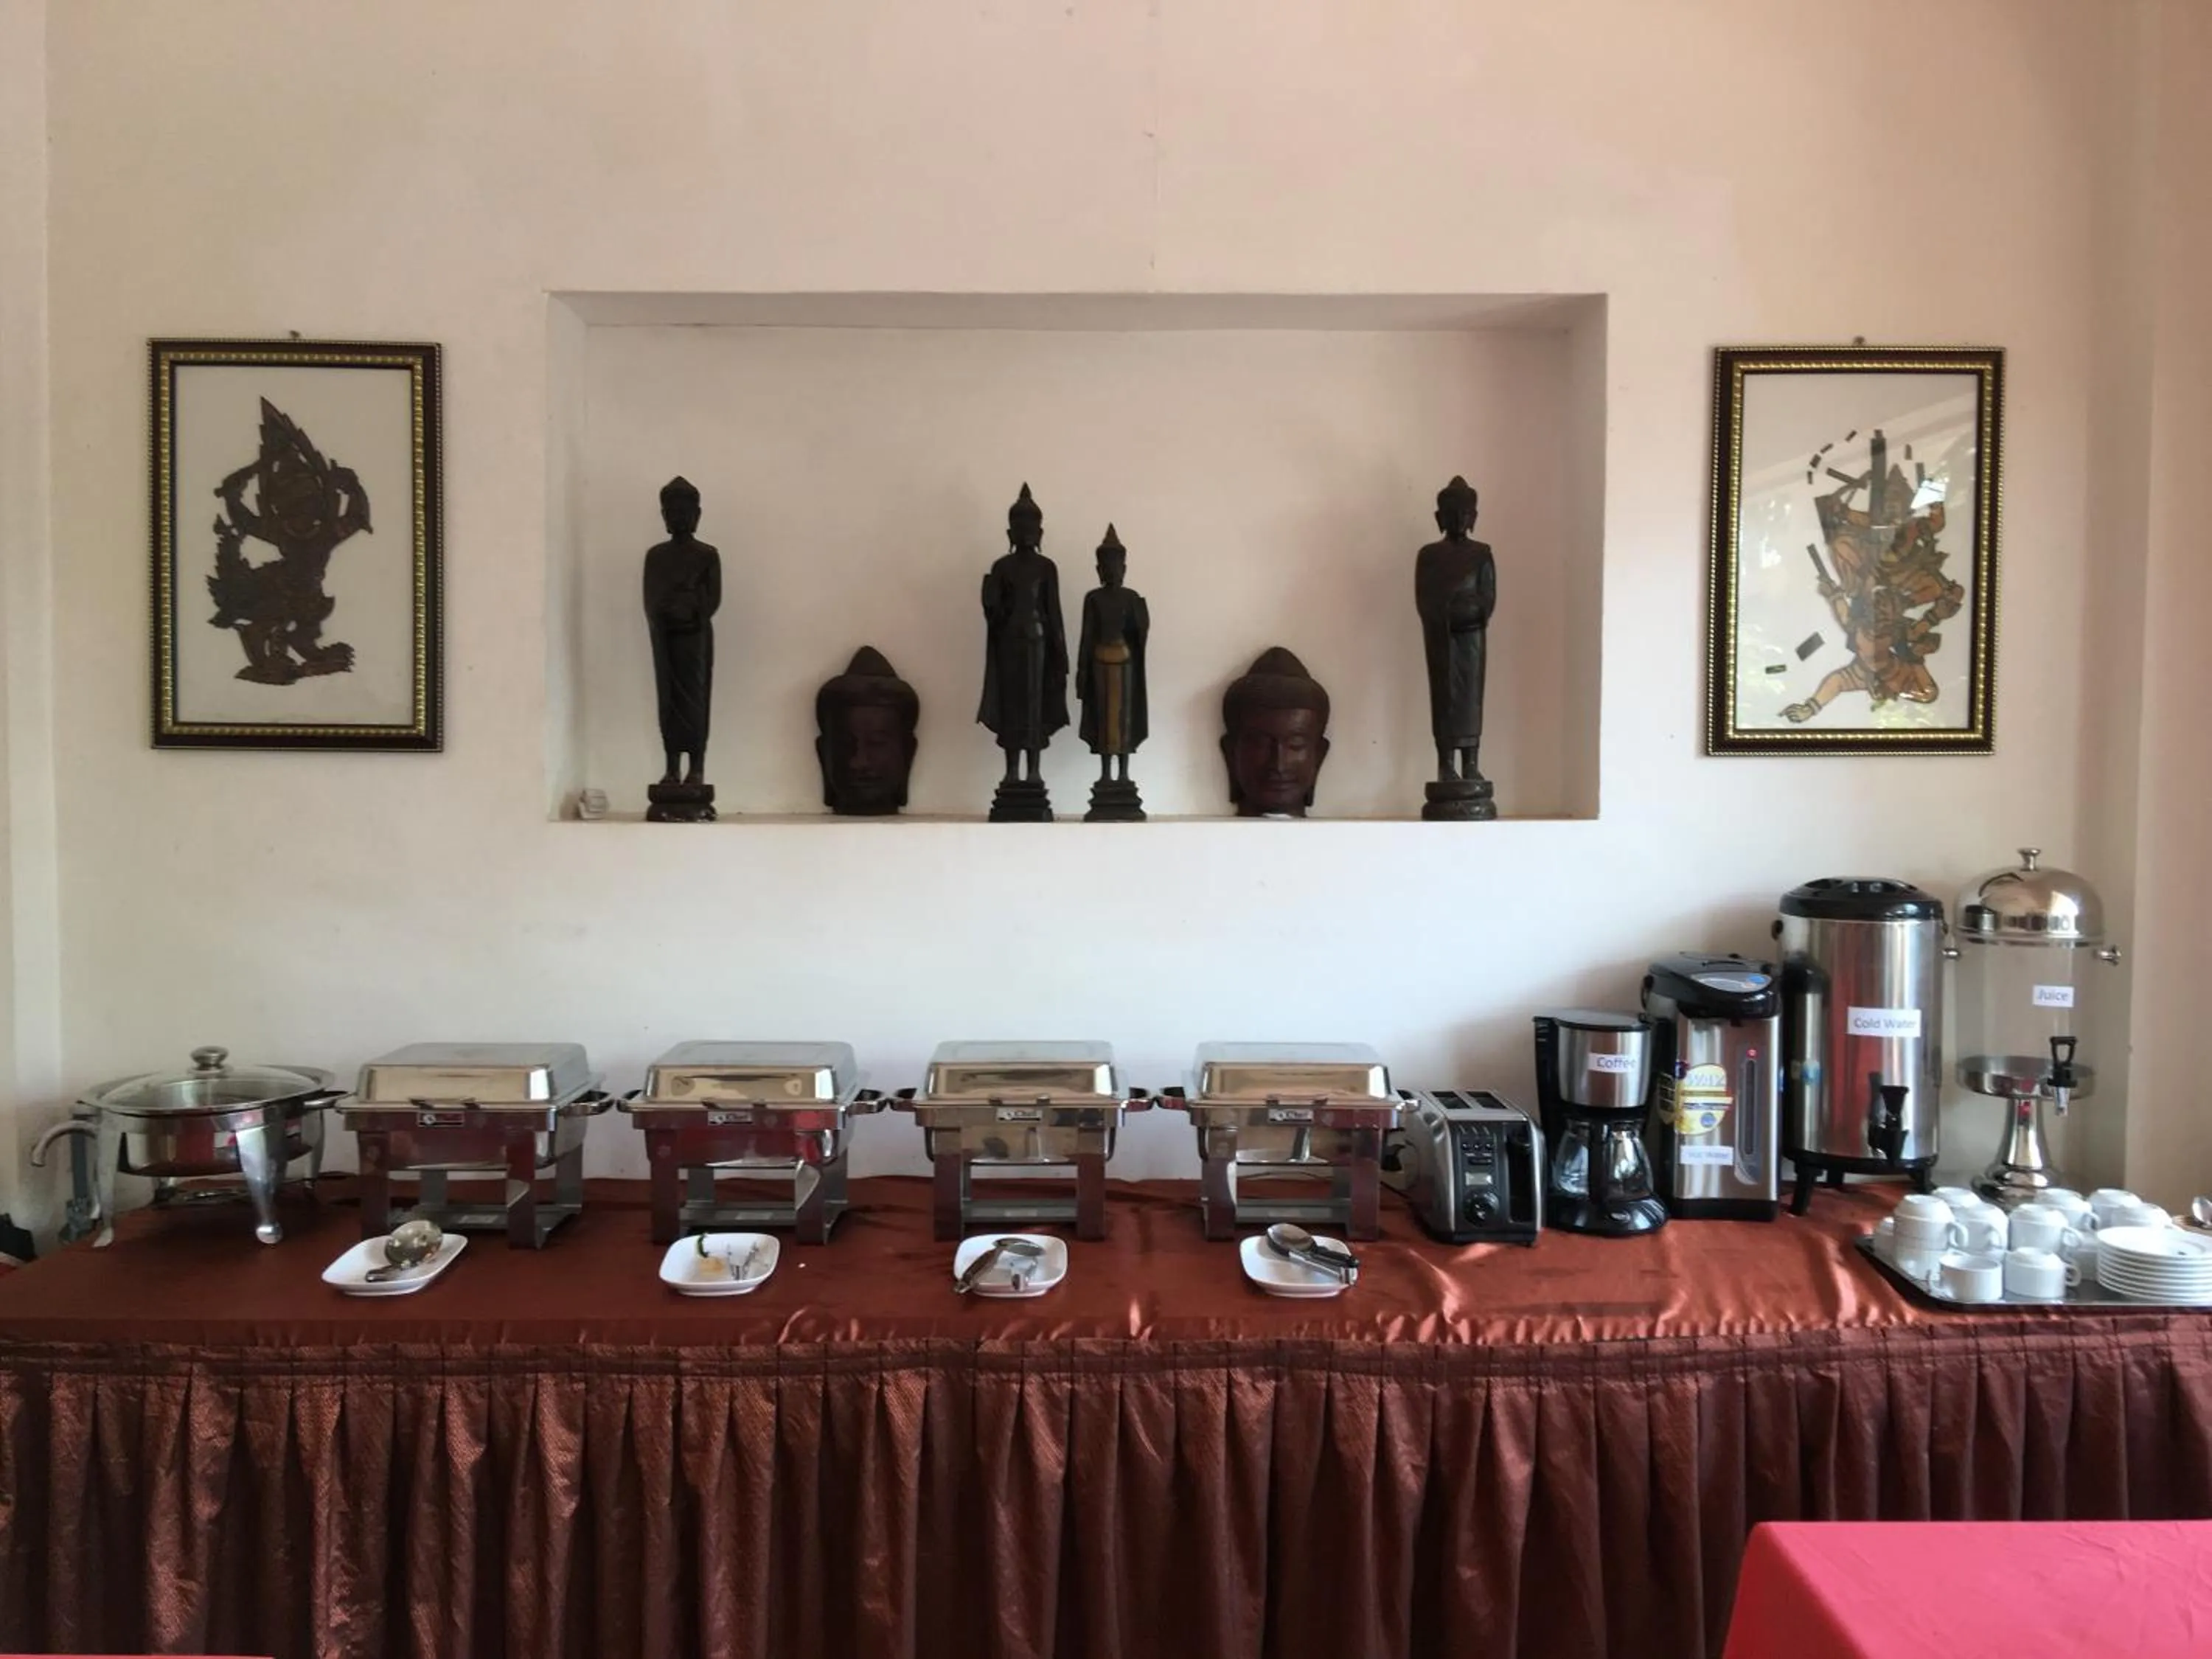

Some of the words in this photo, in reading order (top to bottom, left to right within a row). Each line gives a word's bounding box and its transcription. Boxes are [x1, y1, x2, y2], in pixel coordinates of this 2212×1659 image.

[2038, 988, 2069, 1001] Juice
[1854, 1017, 1880, 1029] Cold
[1885, 1018, 1917, 1029] Water
[1596, 1056, 1637, 1069] Coffee
